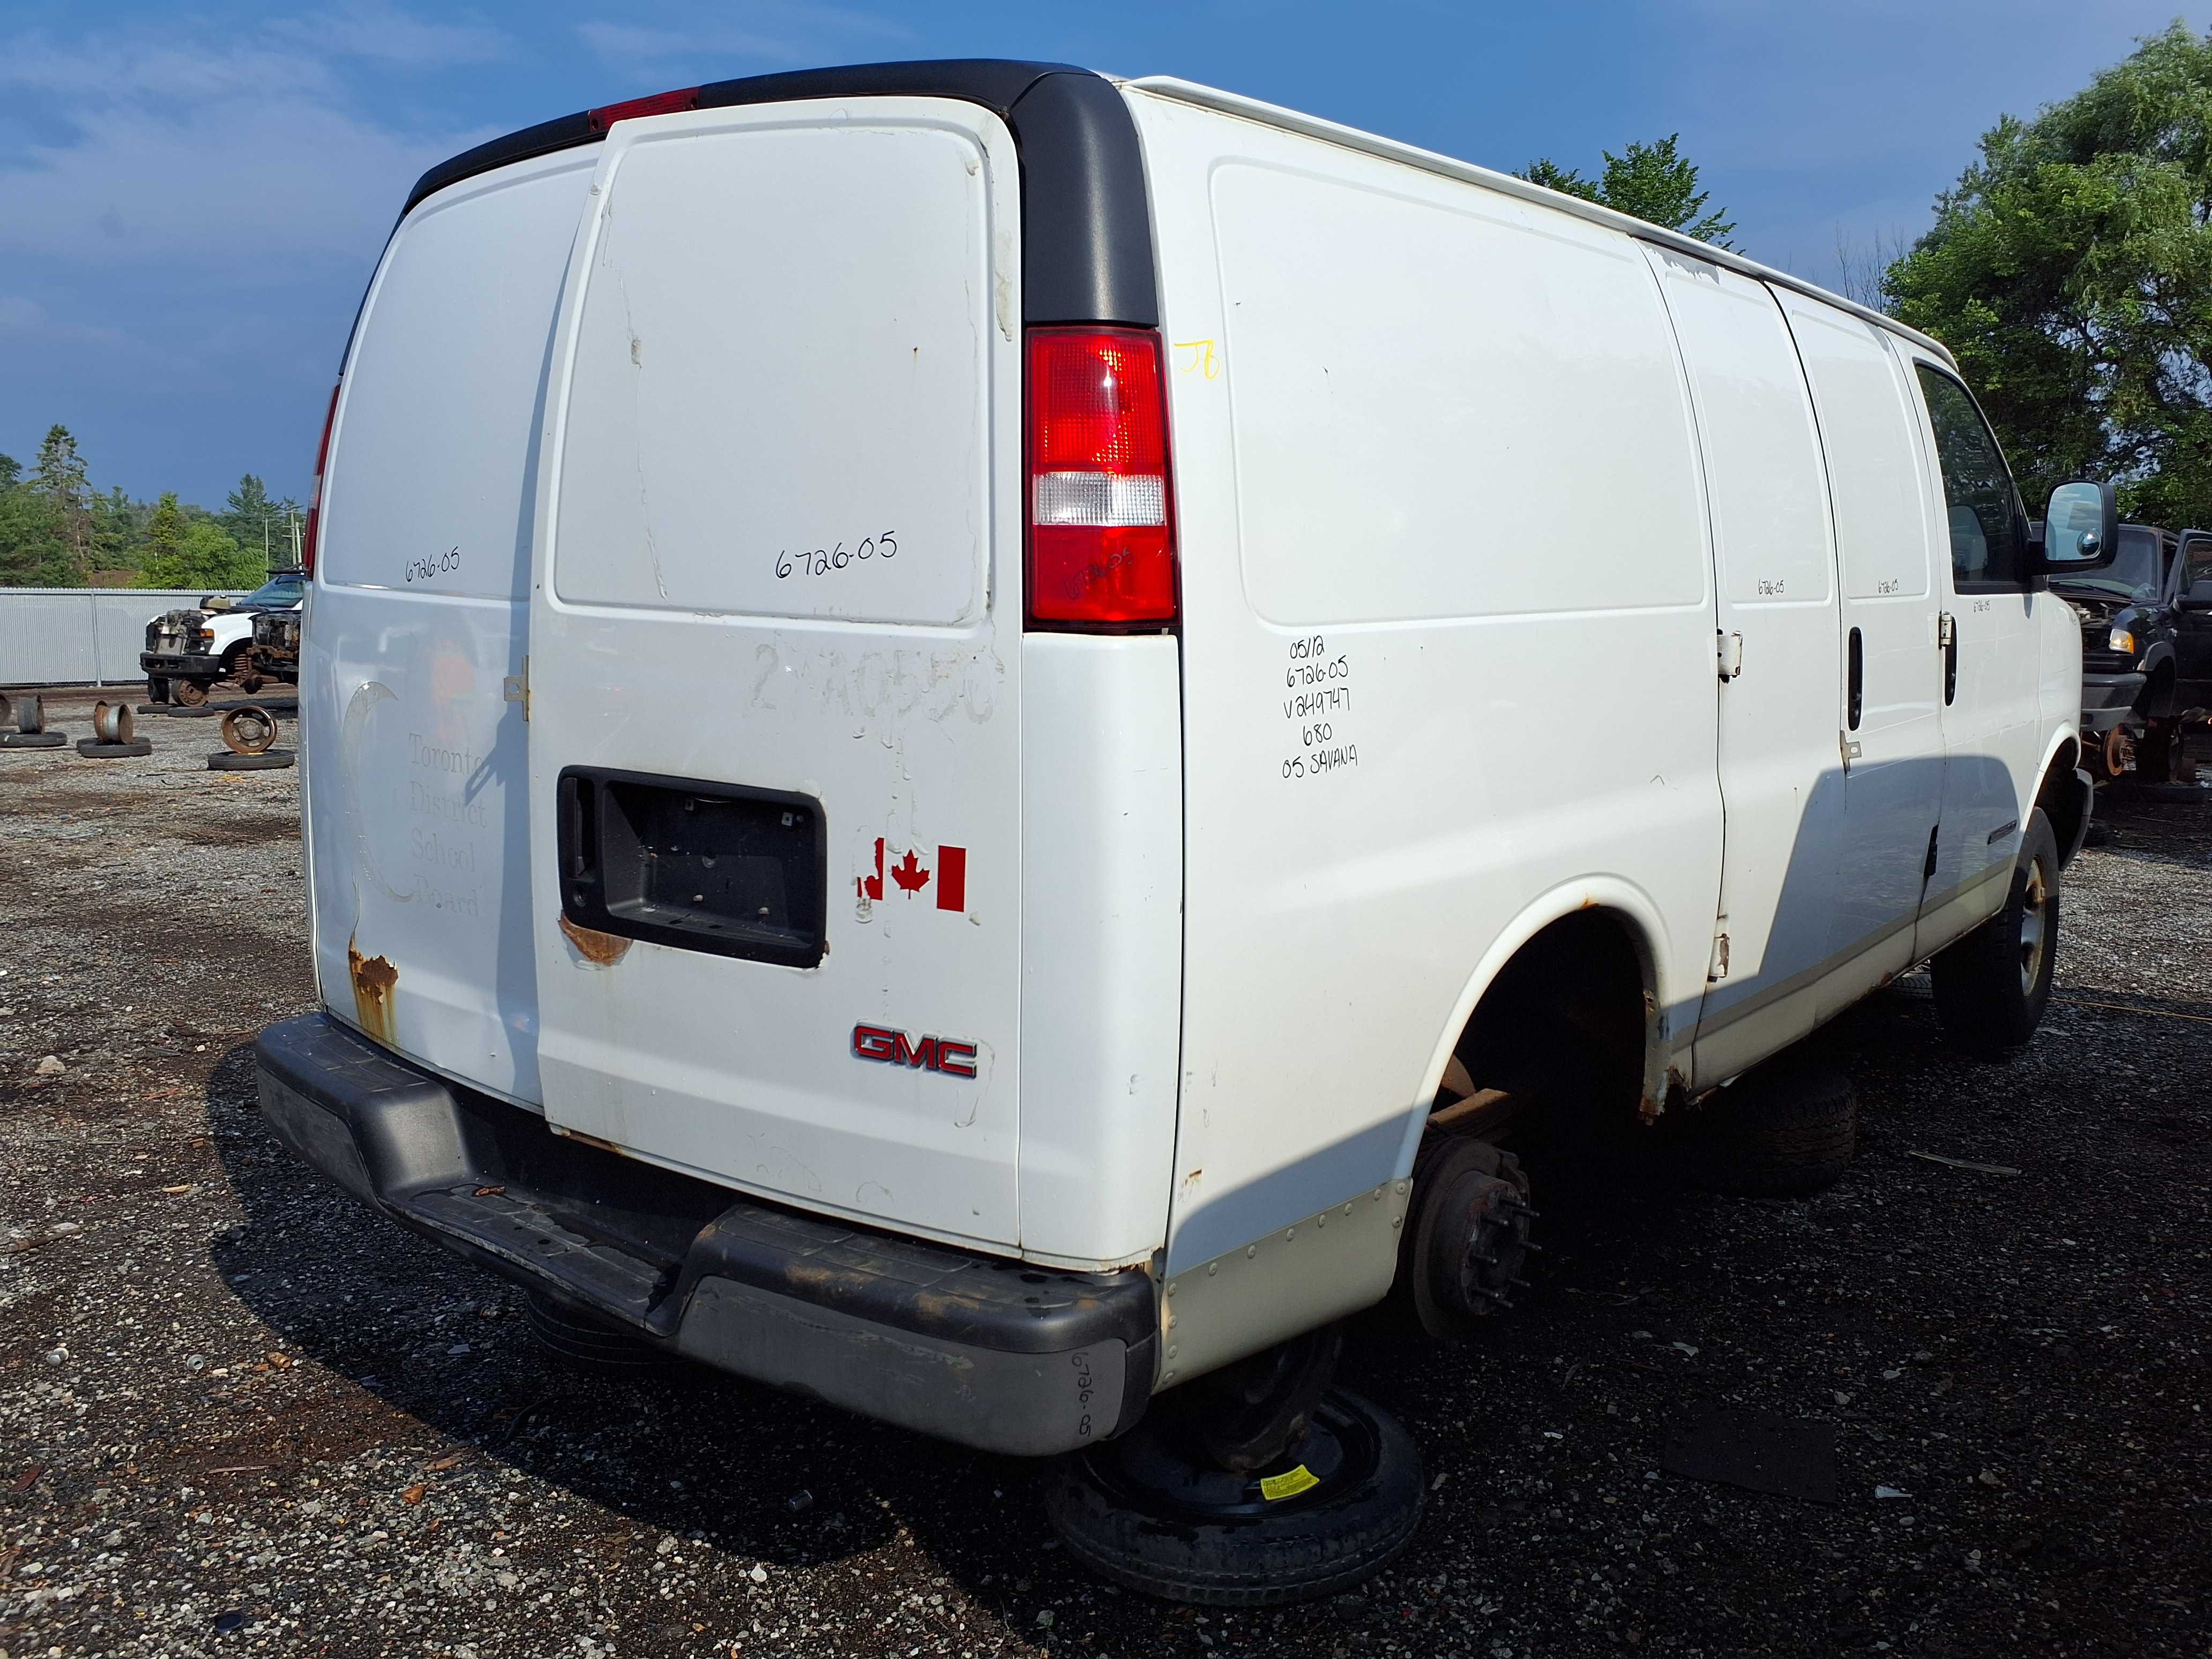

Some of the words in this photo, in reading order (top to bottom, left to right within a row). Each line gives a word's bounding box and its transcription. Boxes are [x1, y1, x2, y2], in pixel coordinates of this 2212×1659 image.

[406, 545, 460, 582] 6726-05
[776, 530, 897, 579] 6726-05
[1287, 654, 1348, 687] 6726-05
[408, 733, 485, 779] Toronto
[1303, 723, 1333, 746] 680
[1282, 756, 1304, 779] 05
[1310, 744, 1358, 774] SAVANA
[409, 780, 488, 829] District
[410, 827, 476, 873] School
[854, 1020, 977, 1079] GMC
